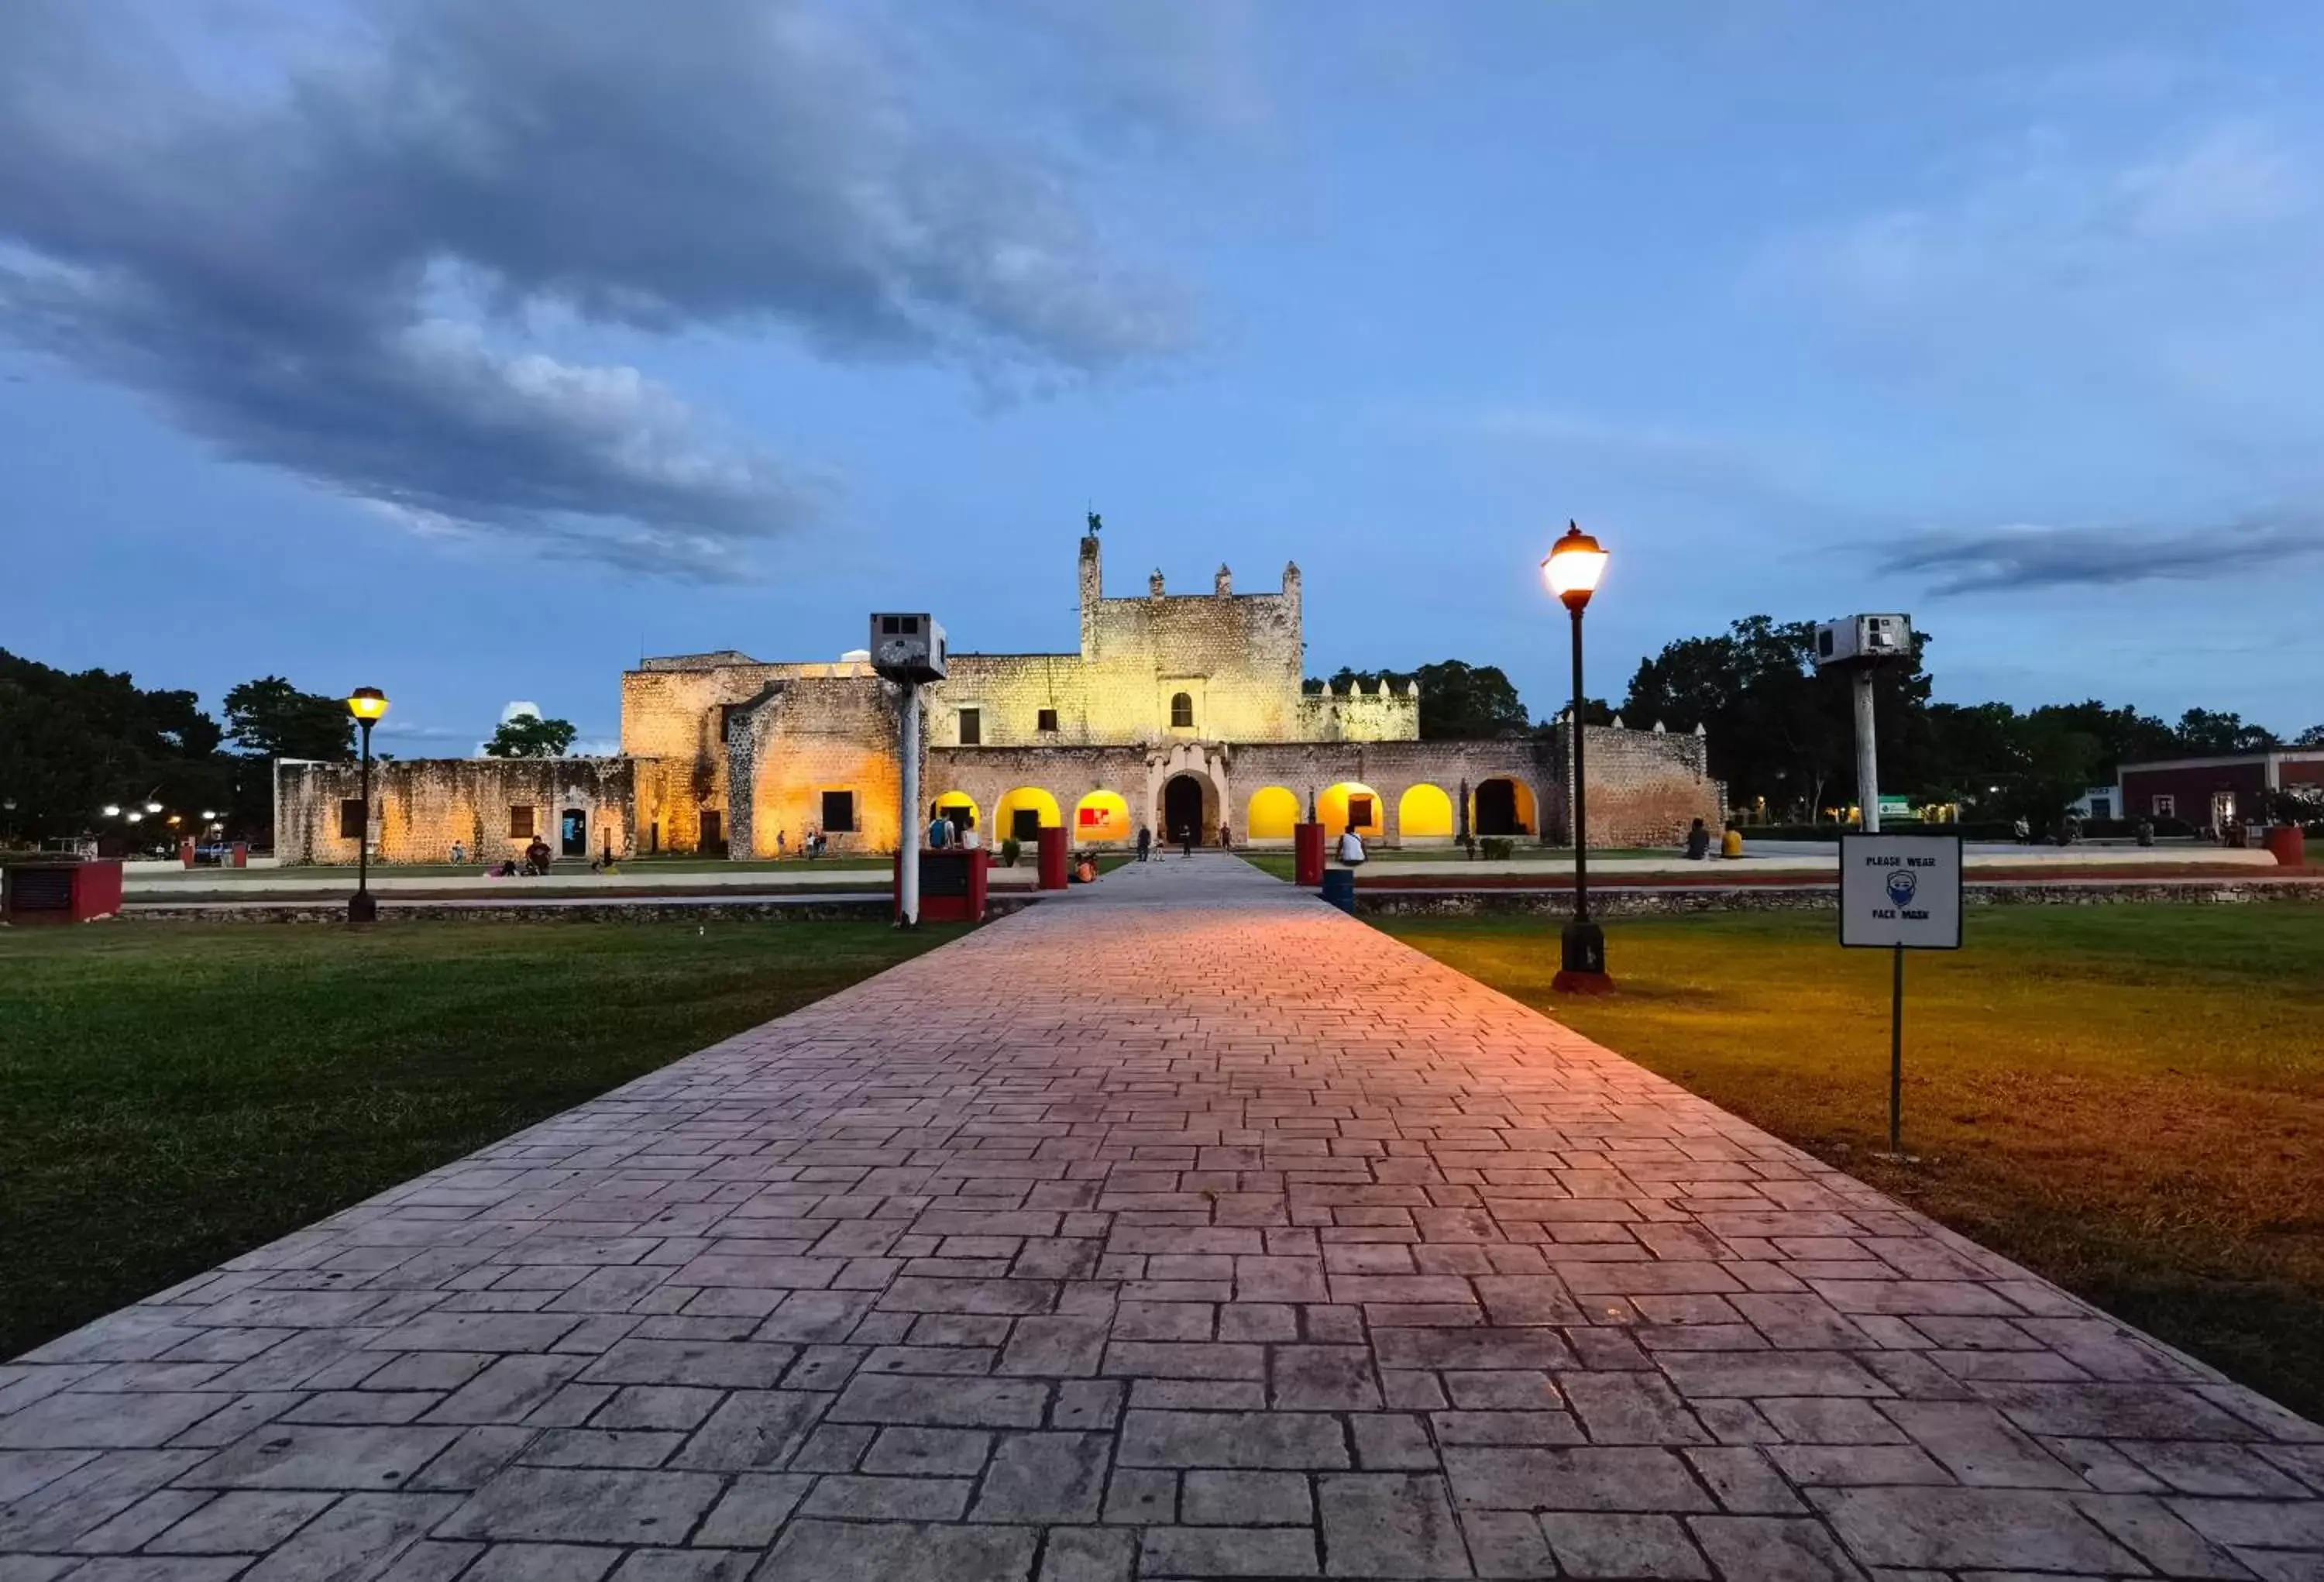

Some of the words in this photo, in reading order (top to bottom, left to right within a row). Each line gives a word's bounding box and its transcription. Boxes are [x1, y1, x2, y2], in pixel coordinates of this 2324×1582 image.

[1865, 856, 1900, 866] PLEASE
[1906, 857, 1936, 867] WEAR
[1872, 909, 1896, 920] FACE
